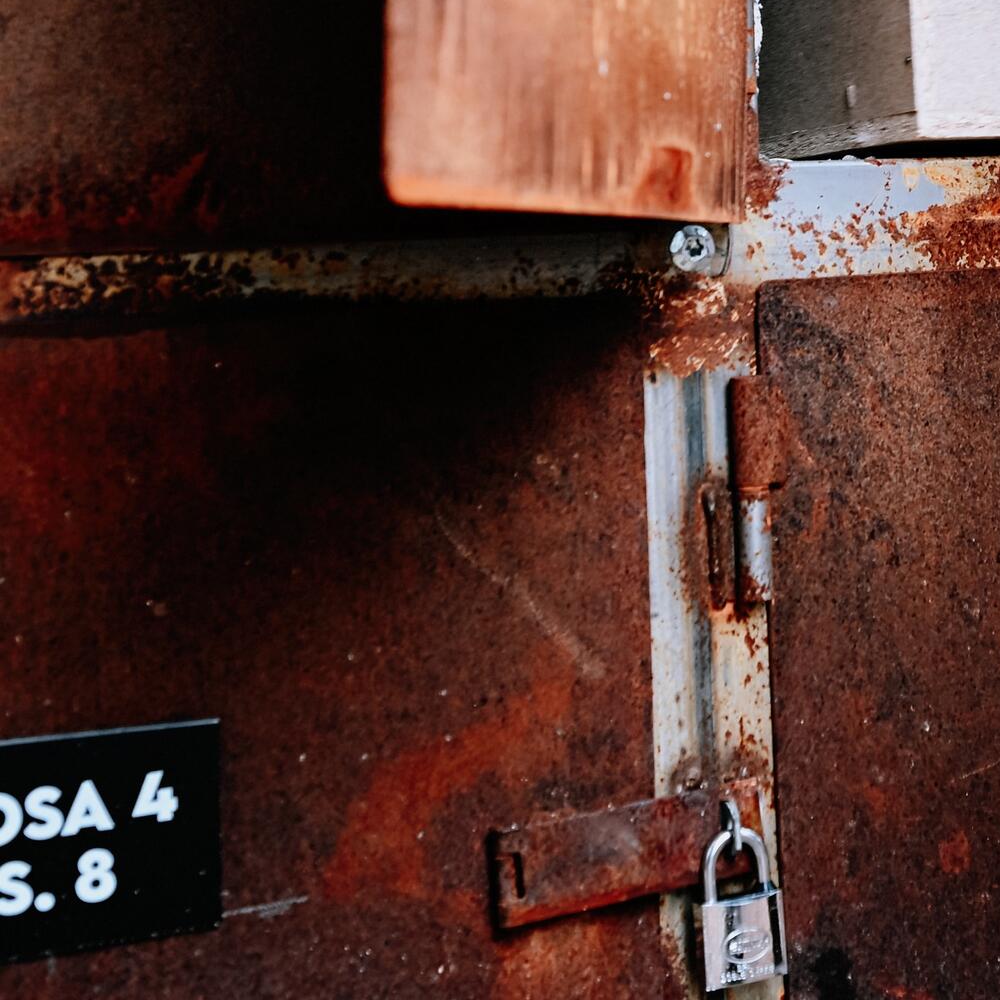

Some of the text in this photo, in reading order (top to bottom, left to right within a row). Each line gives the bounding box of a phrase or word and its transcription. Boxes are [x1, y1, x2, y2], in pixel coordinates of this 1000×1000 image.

[131, 770, 179, 822] 4
[0, 848, 118, 917] S. 8
